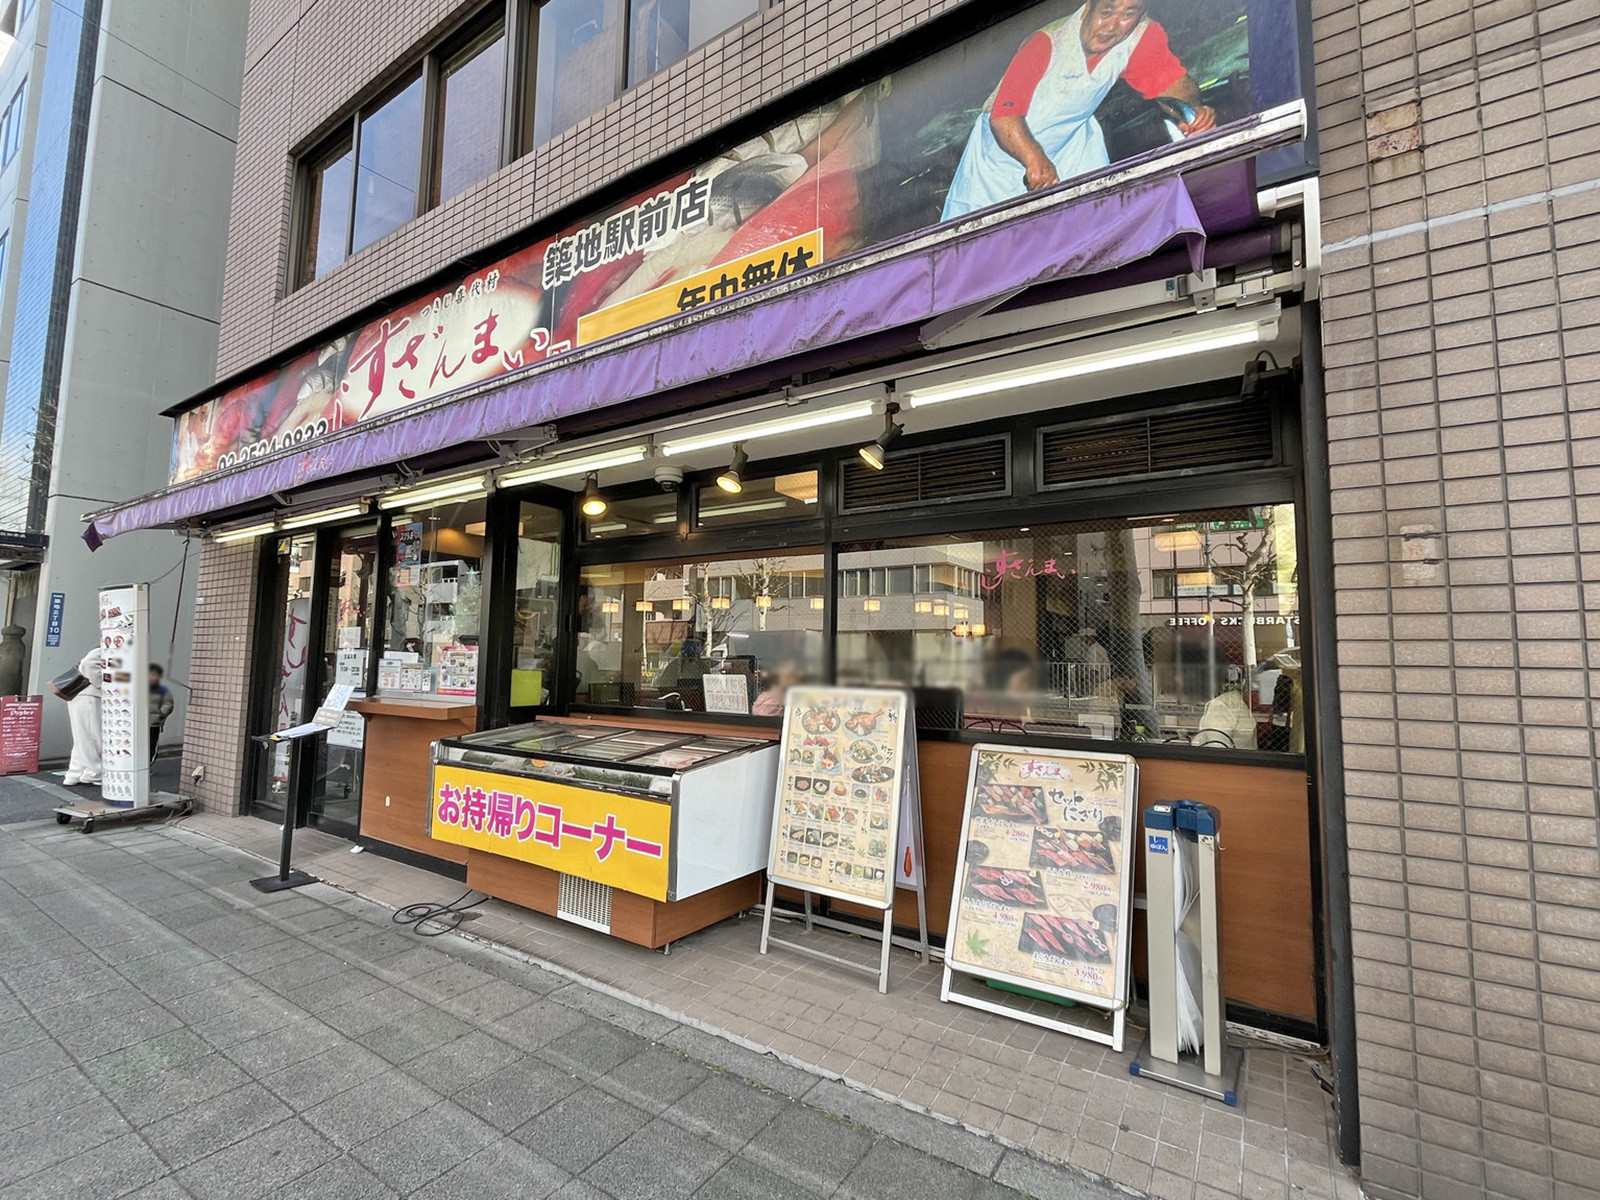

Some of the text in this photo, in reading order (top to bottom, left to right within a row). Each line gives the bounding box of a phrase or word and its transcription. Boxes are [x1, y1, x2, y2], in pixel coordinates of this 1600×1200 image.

[544, 177, 711, 288] 築地駅前店
[421, 271, 499, 318] つきじ喜代村
[677, 246, 814, 311] 年中無休
[437, 782, 663, 862] お持帰りコーナー
[1047, 788, 1085, 806] セット
[1063, 805, 1105, 825] にぎり
